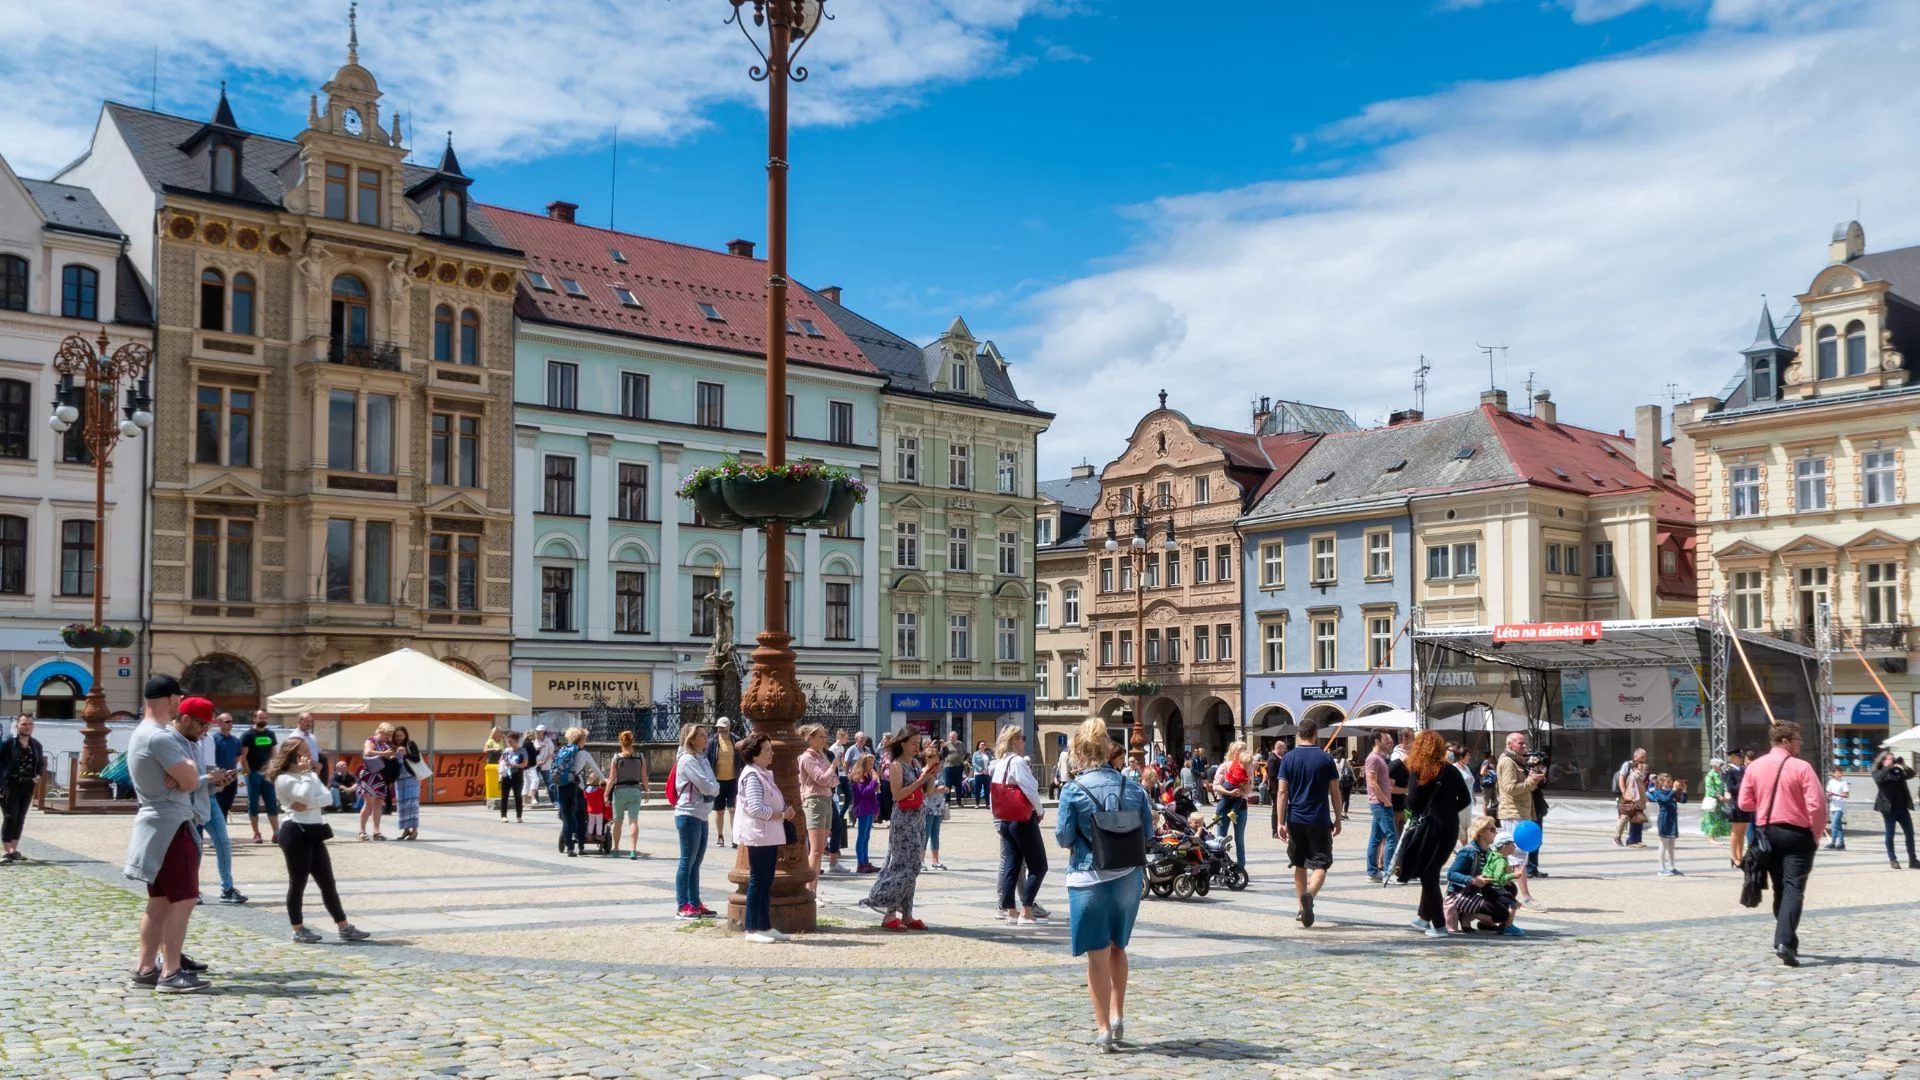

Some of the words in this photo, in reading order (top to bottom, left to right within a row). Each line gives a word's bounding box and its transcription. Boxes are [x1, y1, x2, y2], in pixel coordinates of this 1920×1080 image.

[1497, 627, 1519, 638] Léto
[1522, 628, 1536, 638] na
[1539, 625, 1583, 637] náměstí
[548, 678, 638, 691] PAPÍRNICTVÍ
[823, 677, 839, 691] Čaj
[1425, 671, 1476, 686] OKANTA
[931, 696, 1019, 709] KLENOTNICTVÍ
[436, 755, 484, 778] Letní
